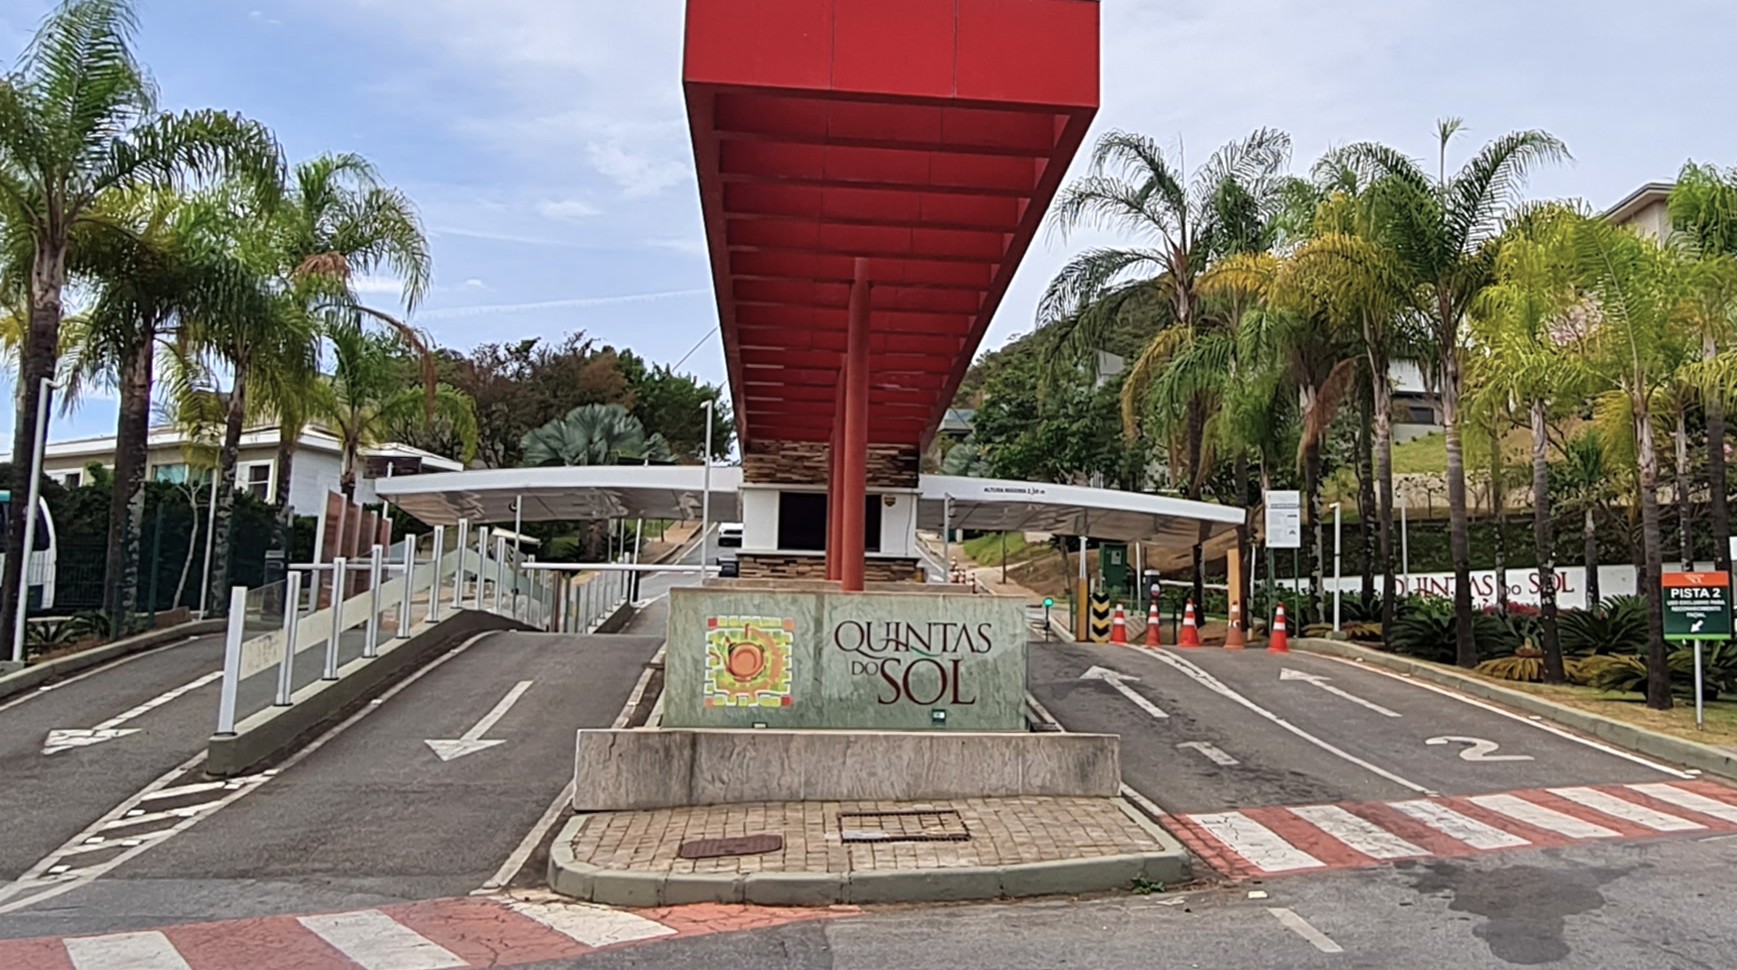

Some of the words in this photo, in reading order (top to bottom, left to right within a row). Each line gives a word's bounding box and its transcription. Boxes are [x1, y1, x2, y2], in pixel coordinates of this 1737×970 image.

[1670, 588, 1710, 598] PISTA
[1712, 588, 1721, 598] 2
[834, 620, 992, 659] QUINTAS
[851, 661, 879, 676] DO
[877, 657, 976, 706] SOL
[1425, 736, 1535, 761] 2
